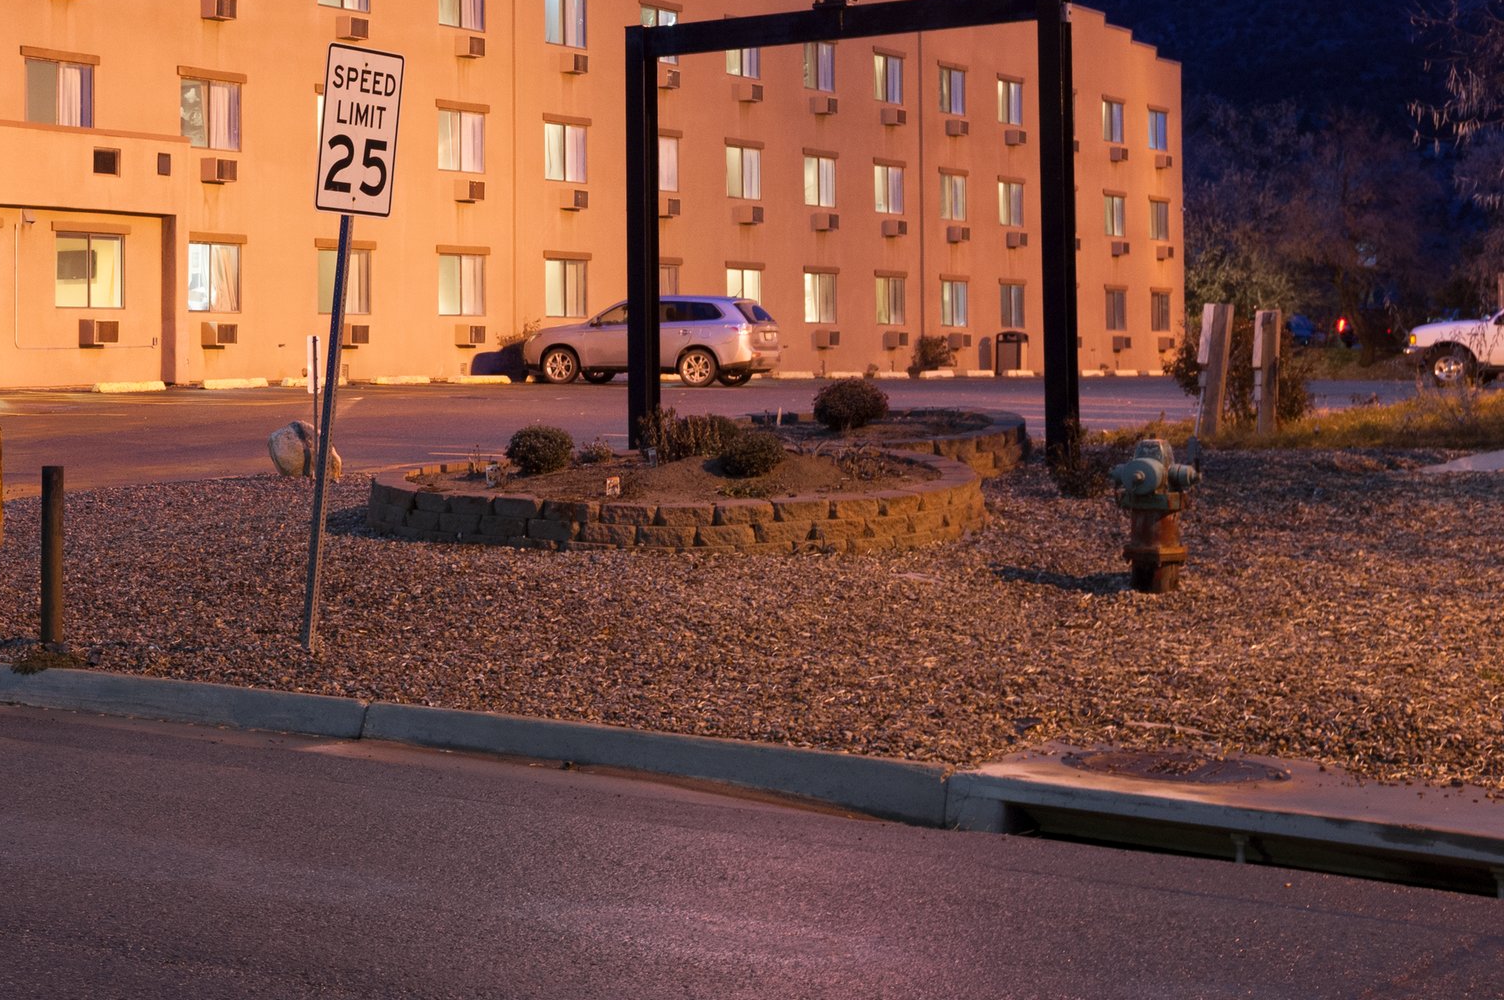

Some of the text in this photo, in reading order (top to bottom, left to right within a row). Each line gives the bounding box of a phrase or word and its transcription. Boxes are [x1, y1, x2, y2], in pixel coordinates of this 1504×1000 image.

[332, 65, 396, 97] SPEED
[337, 100, 387, 130] LIMIT
[324, 134, 388, 197] 25
